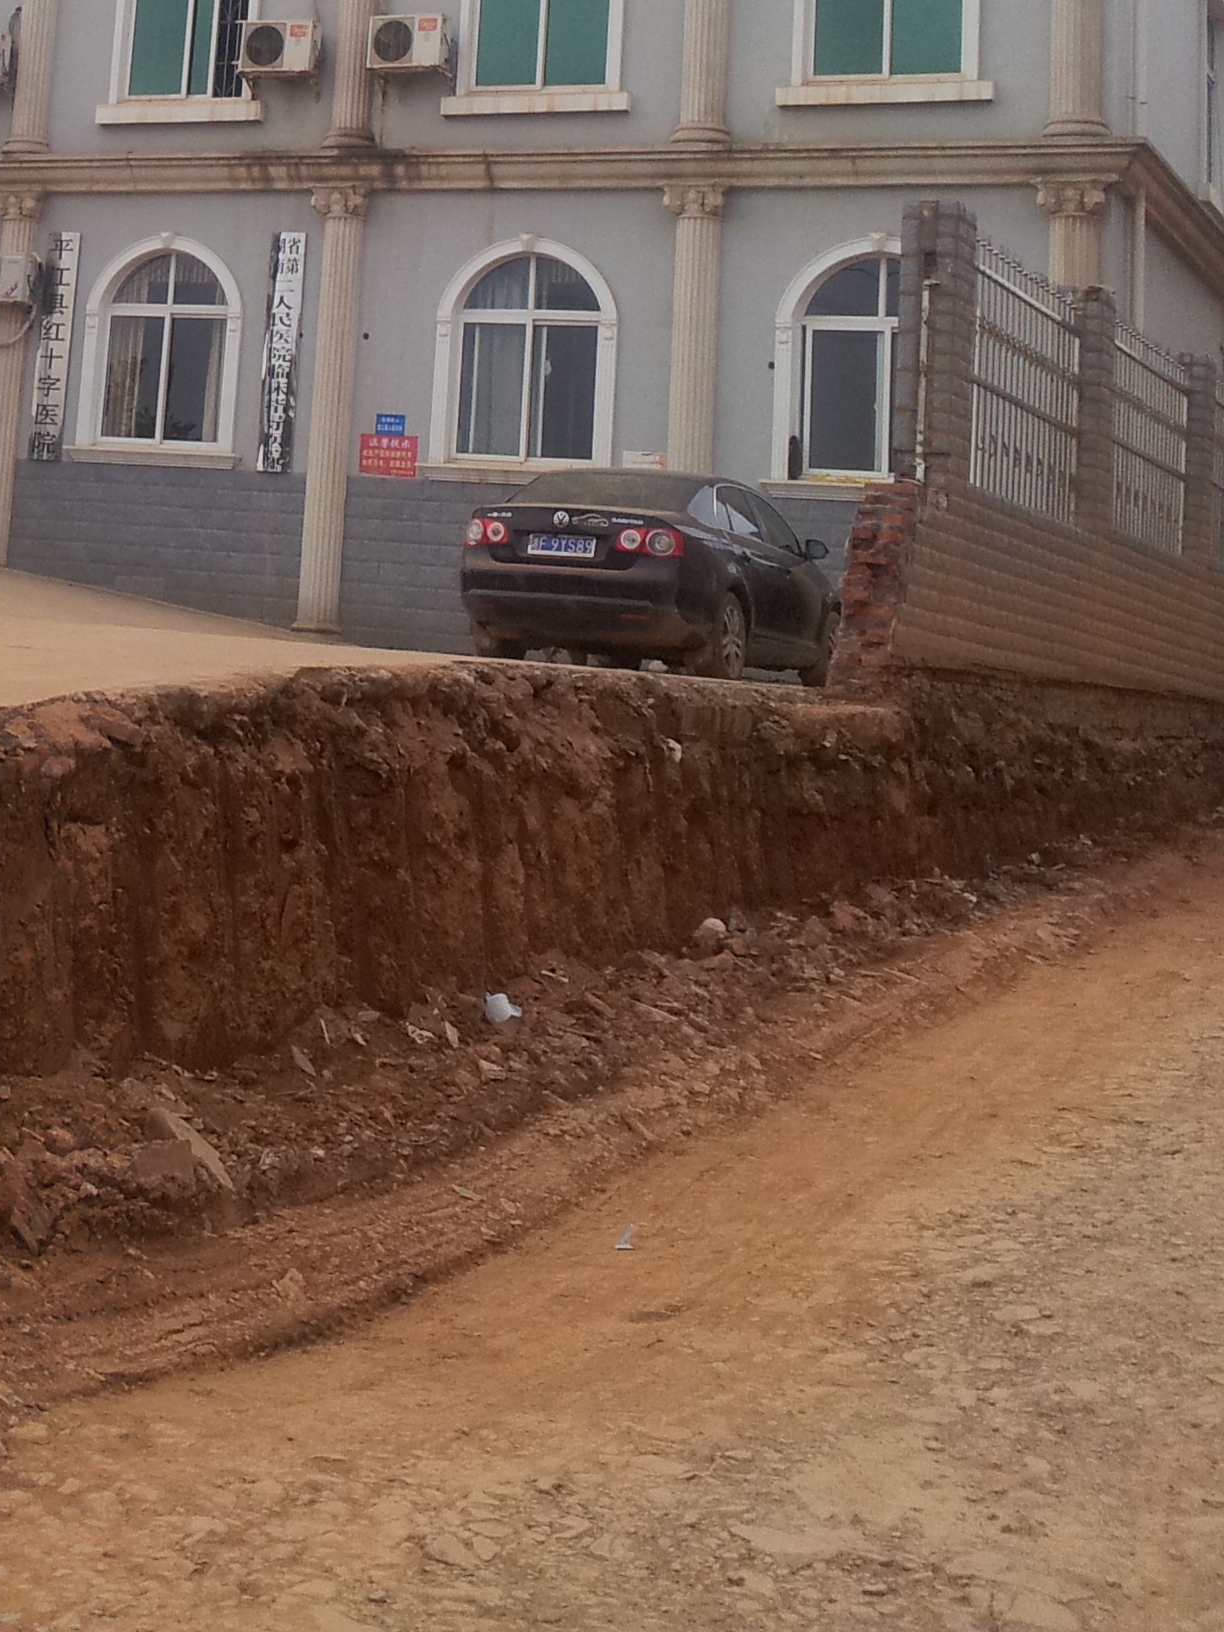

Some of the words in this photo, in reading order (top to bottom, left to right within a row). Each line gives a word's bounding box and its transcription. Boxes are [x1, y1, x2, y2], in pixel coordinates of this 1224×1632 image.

[30, 237, 74, 455] 平江县红十字医院
